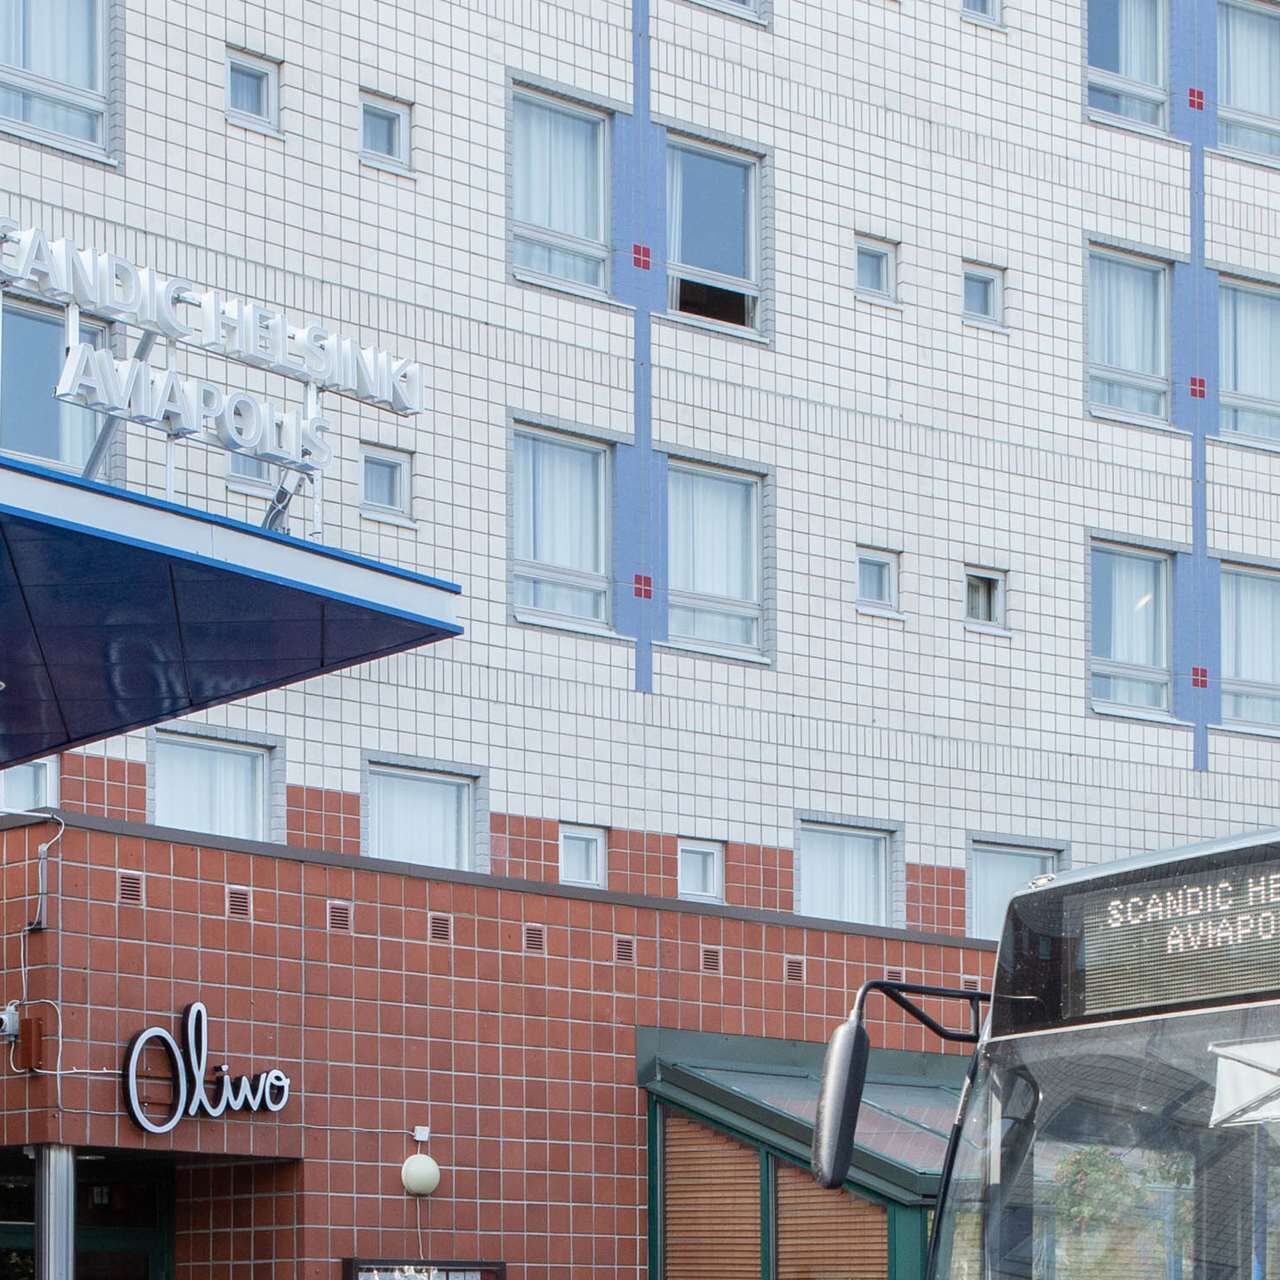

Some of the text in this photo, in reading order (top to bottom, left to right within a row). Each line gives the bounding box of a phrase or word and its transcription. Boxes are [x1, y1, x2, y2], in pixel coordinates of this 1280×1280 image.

[55, 343, 335, 472] AVIAPOLIS
[201, 290, 424, 415] HELSINKI
[1107, 880, 1233, 928] SCANDIC
[125, 1001, 290, 1134] Olivo
